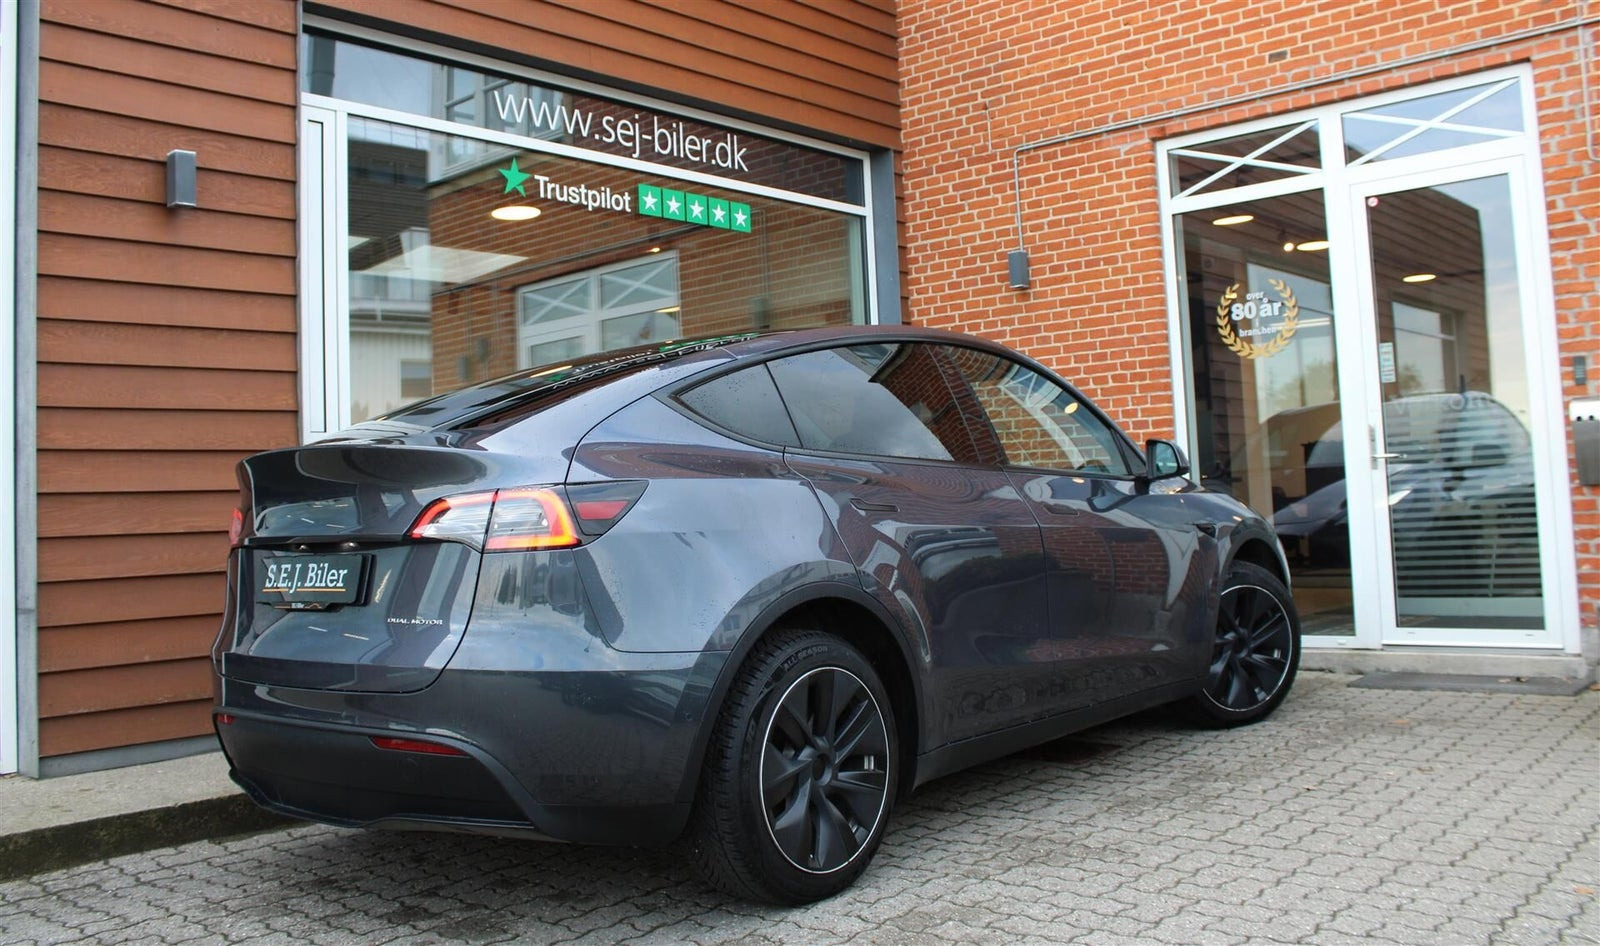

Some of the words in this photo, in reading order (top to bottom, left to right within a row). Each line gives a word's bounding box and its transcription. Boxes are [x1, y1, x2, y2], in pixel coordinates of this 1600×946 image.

[493, 90, 749, 172] www.sej-biler.dk
[534, 174, 632, 213] Trustpilot
[1231, 301, 1257, 321] 80
[1260, 298, 1281, 317] år
[1246, 292, 1264, 300] over
[265, 564, 301, 593] S.E.J.
[304, 563, 347, 587] Biler
